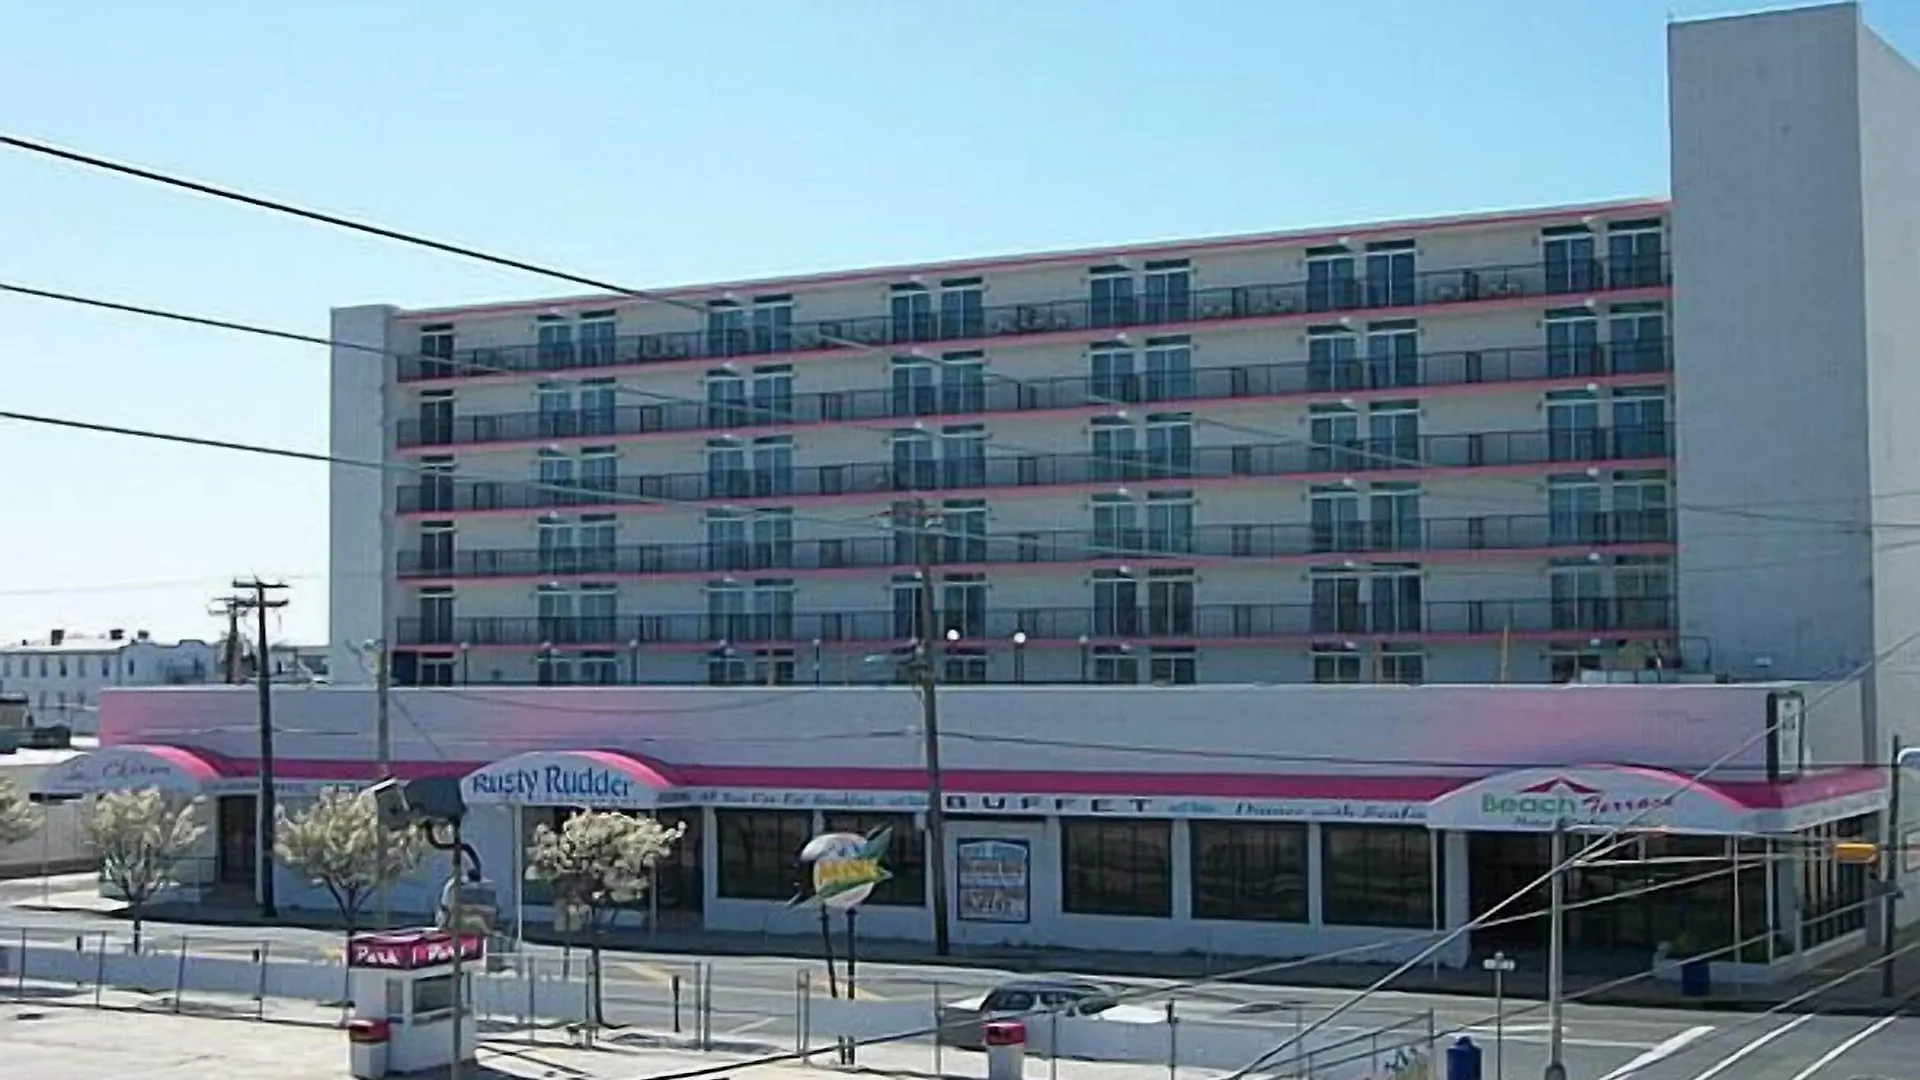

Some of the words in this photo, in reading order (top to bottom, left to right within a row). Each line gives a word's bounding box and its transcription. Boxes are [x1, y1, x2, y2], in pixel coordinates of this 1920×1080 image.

[472, 766, 537, 799] Rusty
[545, 763, 632, 797] Rudder
[946, 794, 1154, 813] BUFFET
[1481, 793, 1575, 814] Beach
